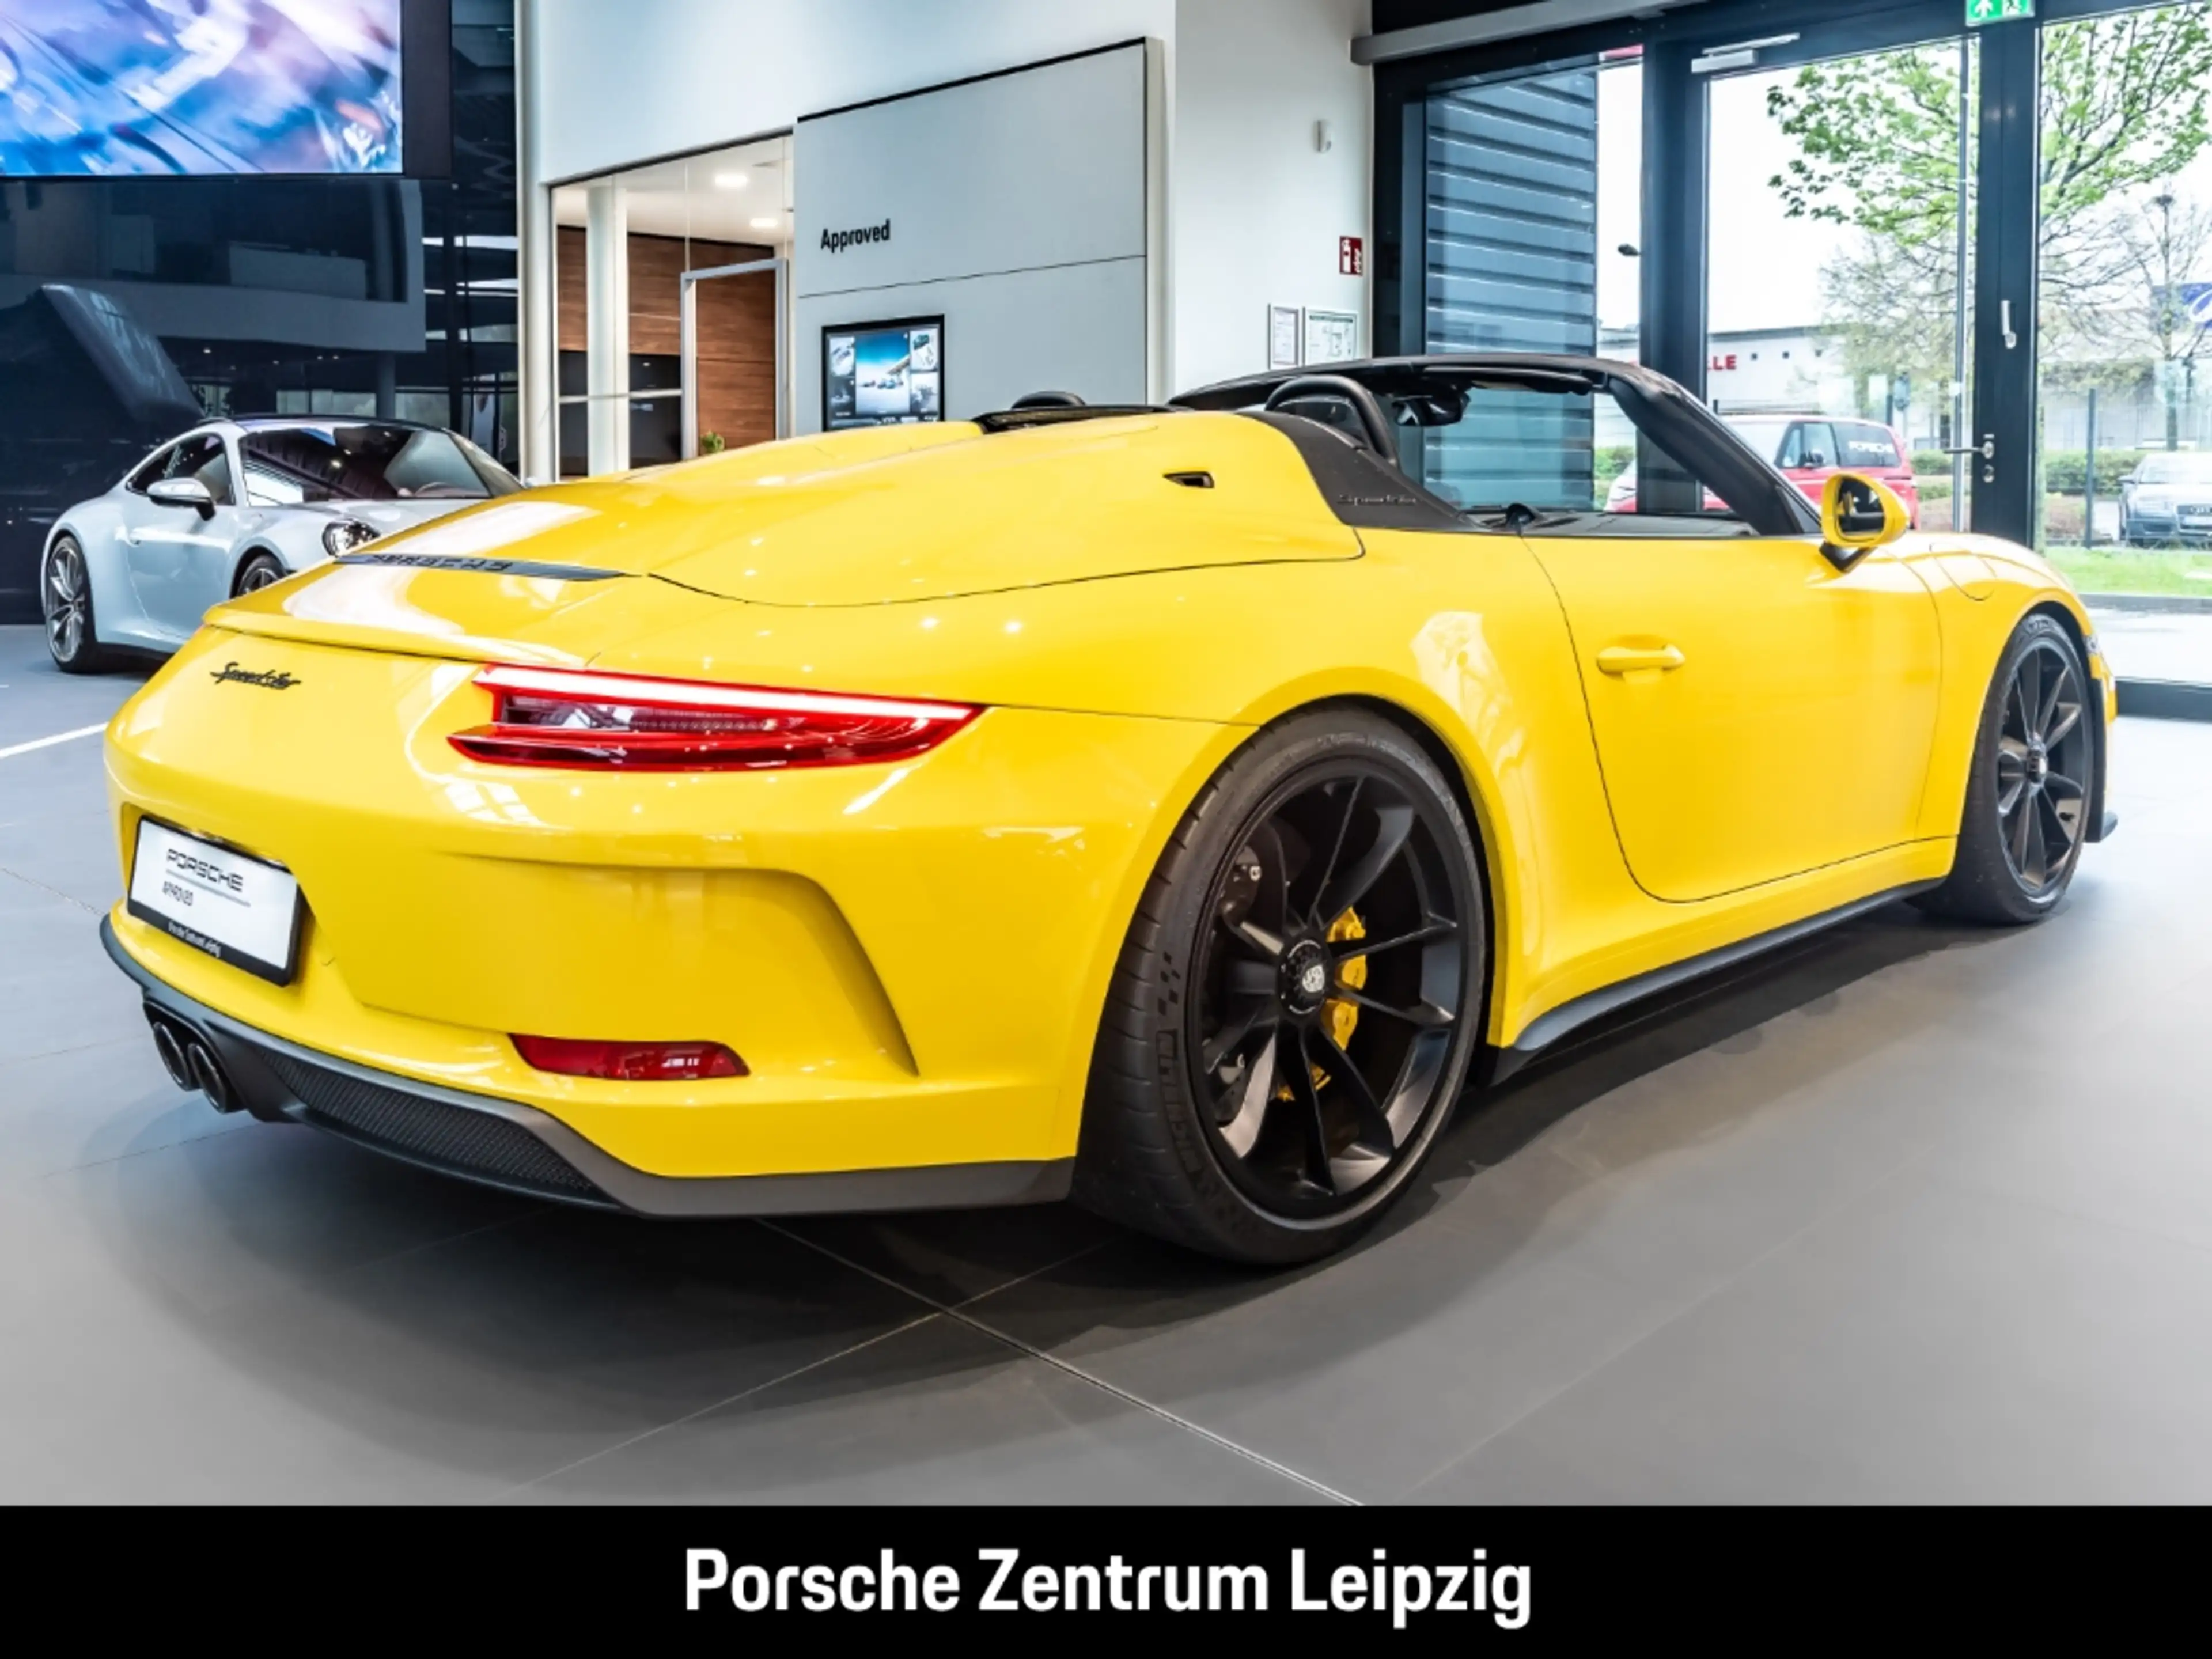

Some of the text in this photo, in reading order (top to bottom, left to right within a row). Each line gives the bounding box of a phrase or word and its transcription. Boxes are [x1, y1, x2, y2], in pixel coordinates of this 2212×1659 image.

[820, 218, 891, 253] Approved
[1707, 354, 1737, 370] LE
[210, 661, 301, 690] Speedster
[166, 848, 243, 892] PORSCHE
